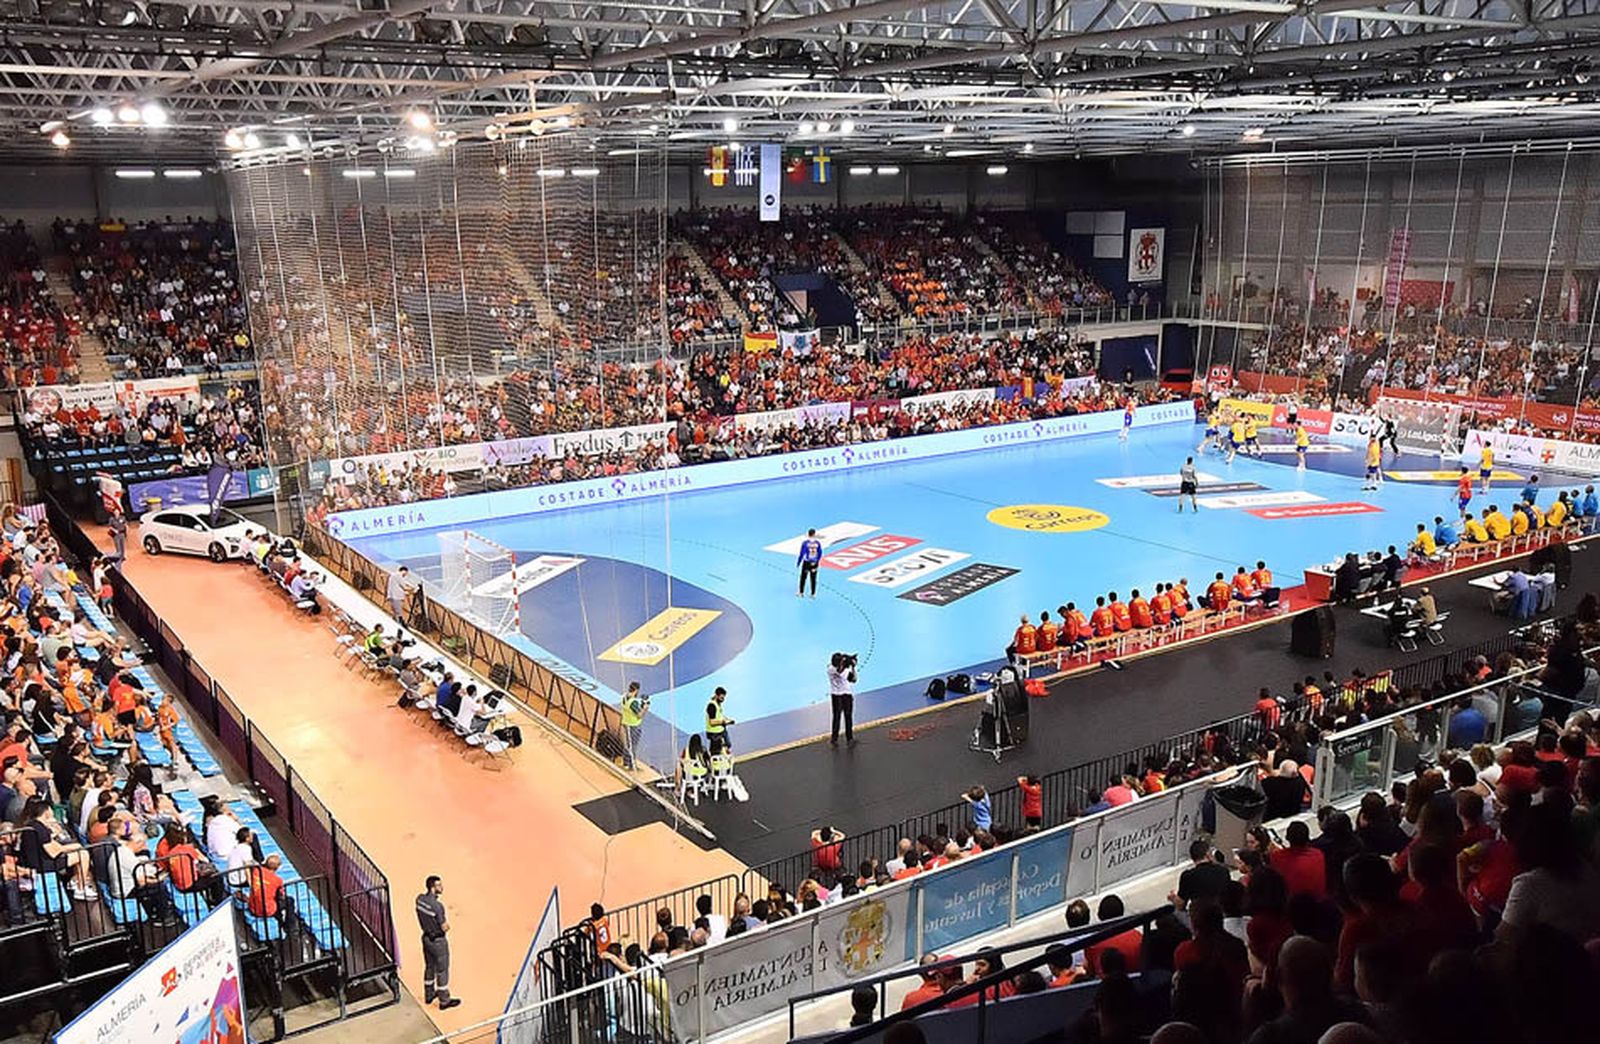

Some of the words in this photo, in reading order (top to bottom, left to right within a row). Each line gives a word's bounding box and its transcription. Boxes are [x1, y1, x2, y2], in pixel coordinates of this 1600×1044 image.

[631, 475, 692, 492] ALMERÍA
[351, 512, 426, 531] ALMERÍA
[825, 536, 908, 568] AVIS
